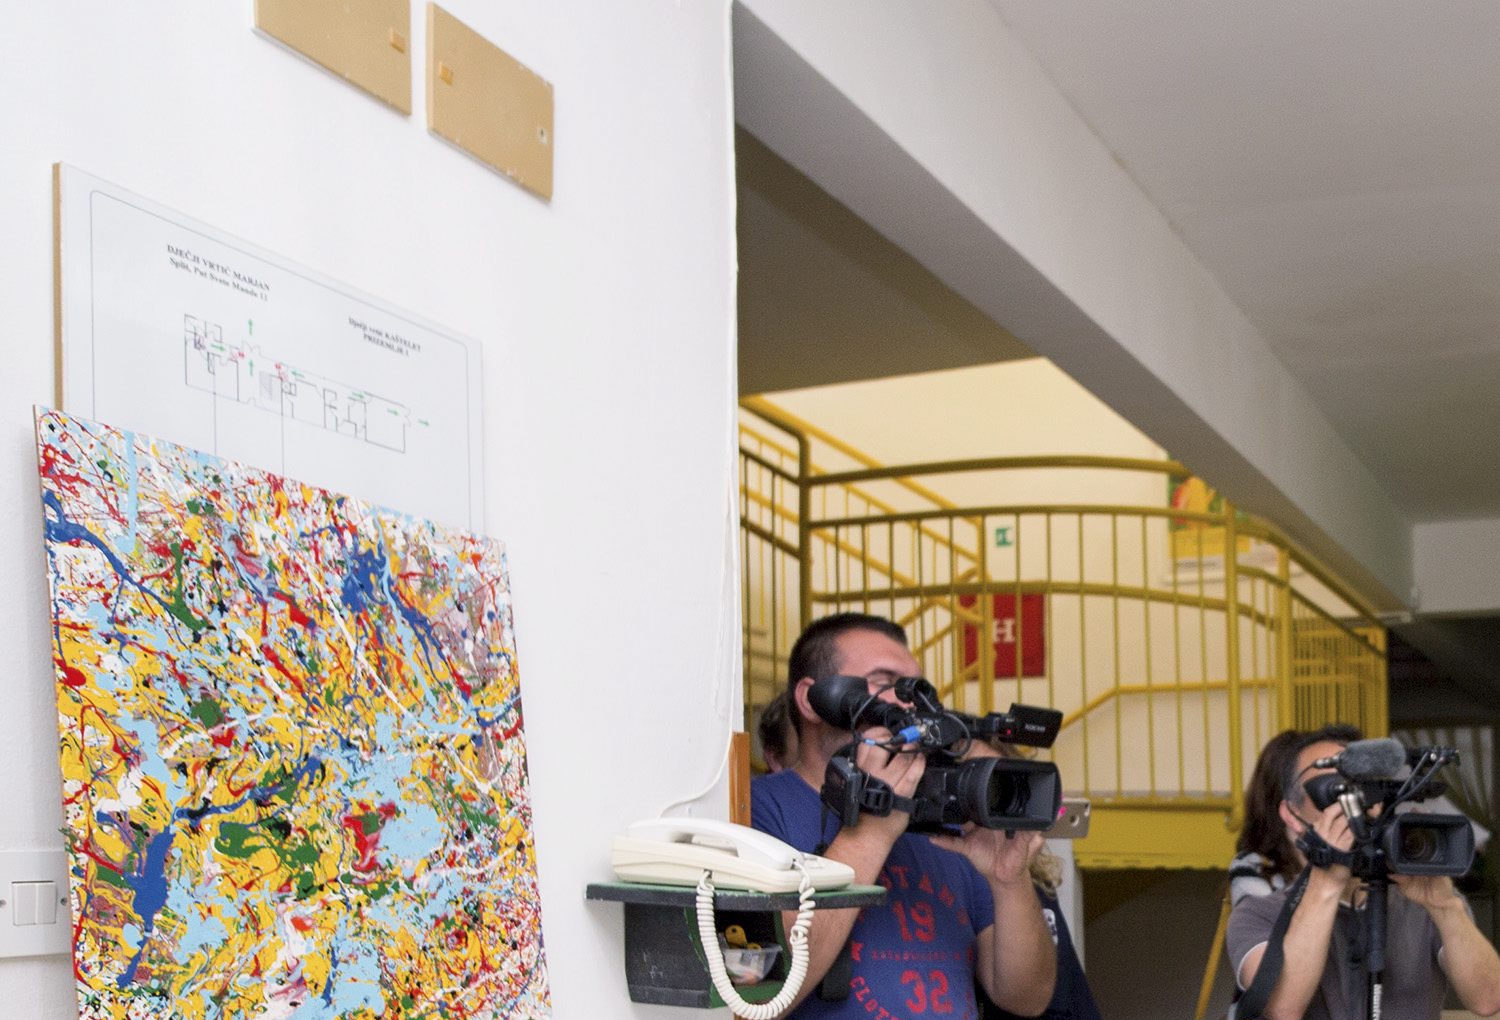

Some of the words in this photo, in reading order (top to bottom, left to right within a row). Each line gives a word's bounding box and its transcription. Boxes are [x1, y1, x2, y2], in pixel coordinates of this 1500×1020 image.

[233, 271, 270, 291] MARJAN
[993, 618, 1017, 643] H
[892, 901, 936, 943] 19
[900, 969, 953, 1014] 32
